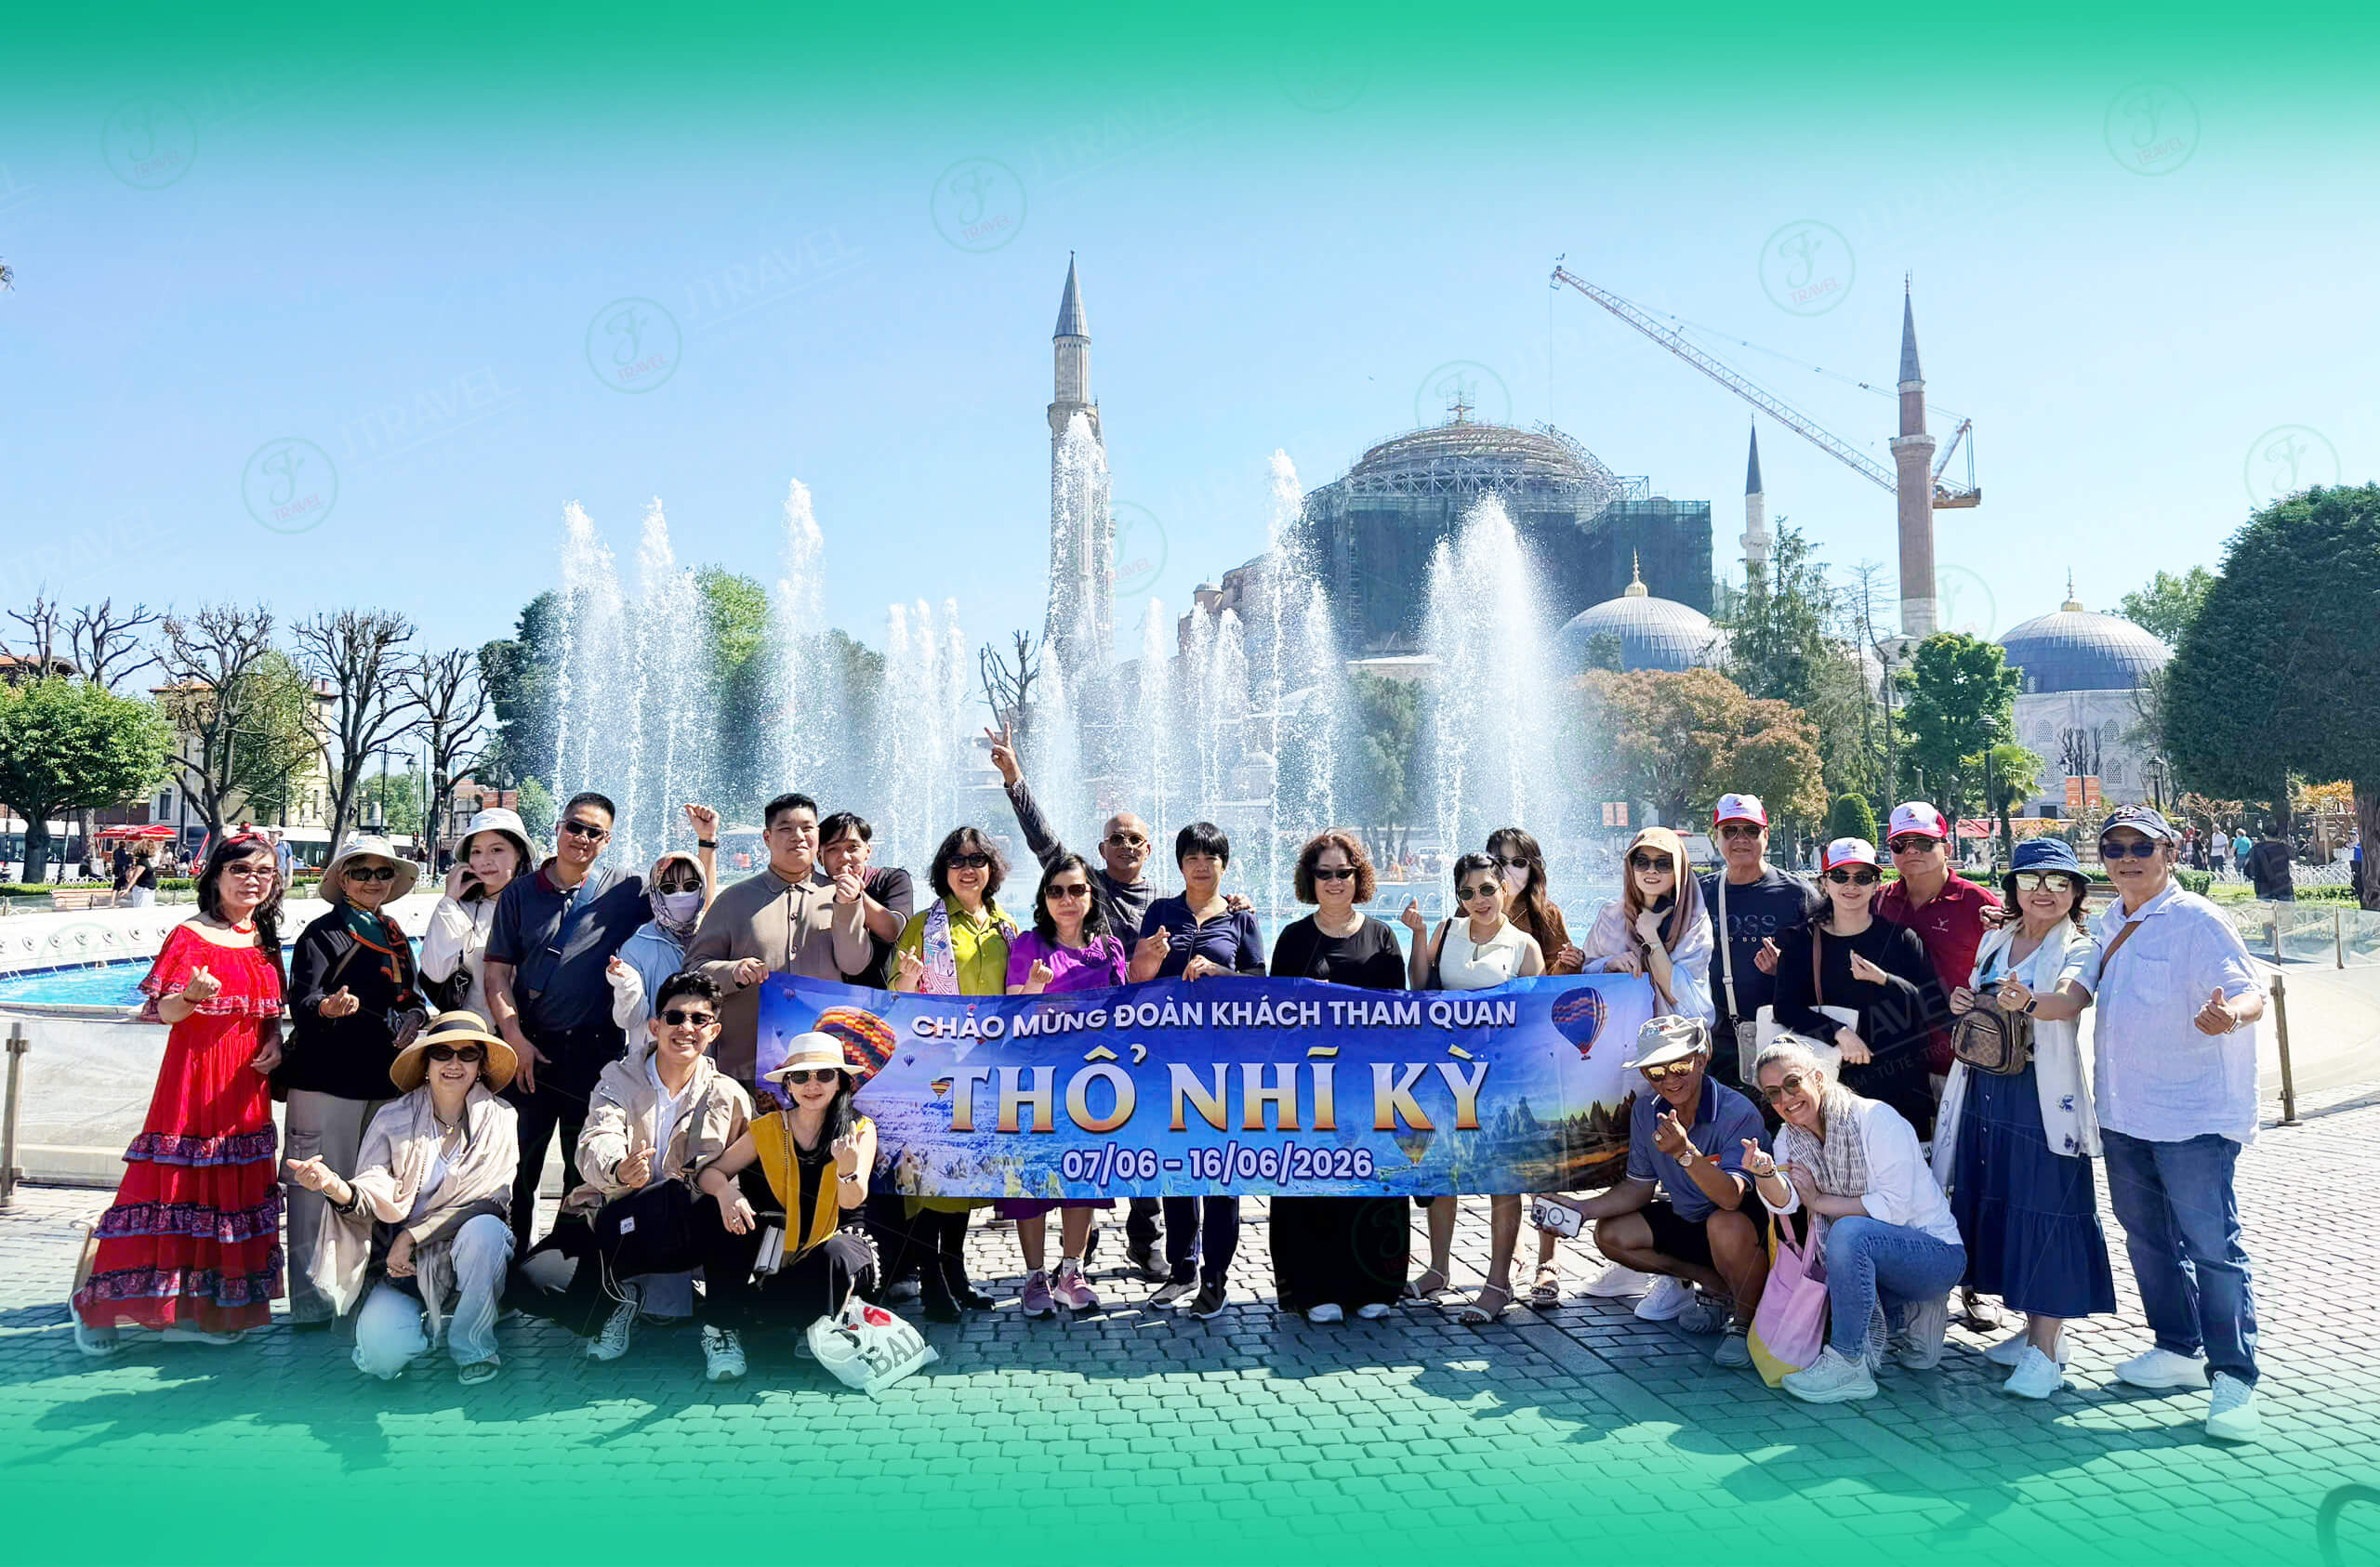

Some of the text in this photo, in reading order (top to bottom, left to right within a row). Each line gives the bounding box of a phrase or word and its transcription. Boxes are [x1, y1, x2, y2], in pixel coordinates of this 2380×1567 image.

[911, 994, 1516, 1038] CHÀO MỪNG ĐOÀN KHÁCH THAM QUAN
[937, 1044, 1488, 1132] THỔ NHĨ KỲ
[1063, 1143, 1157, 1186] 07/06
[1189, 1141, 1372, 1186] 16/06/2026
